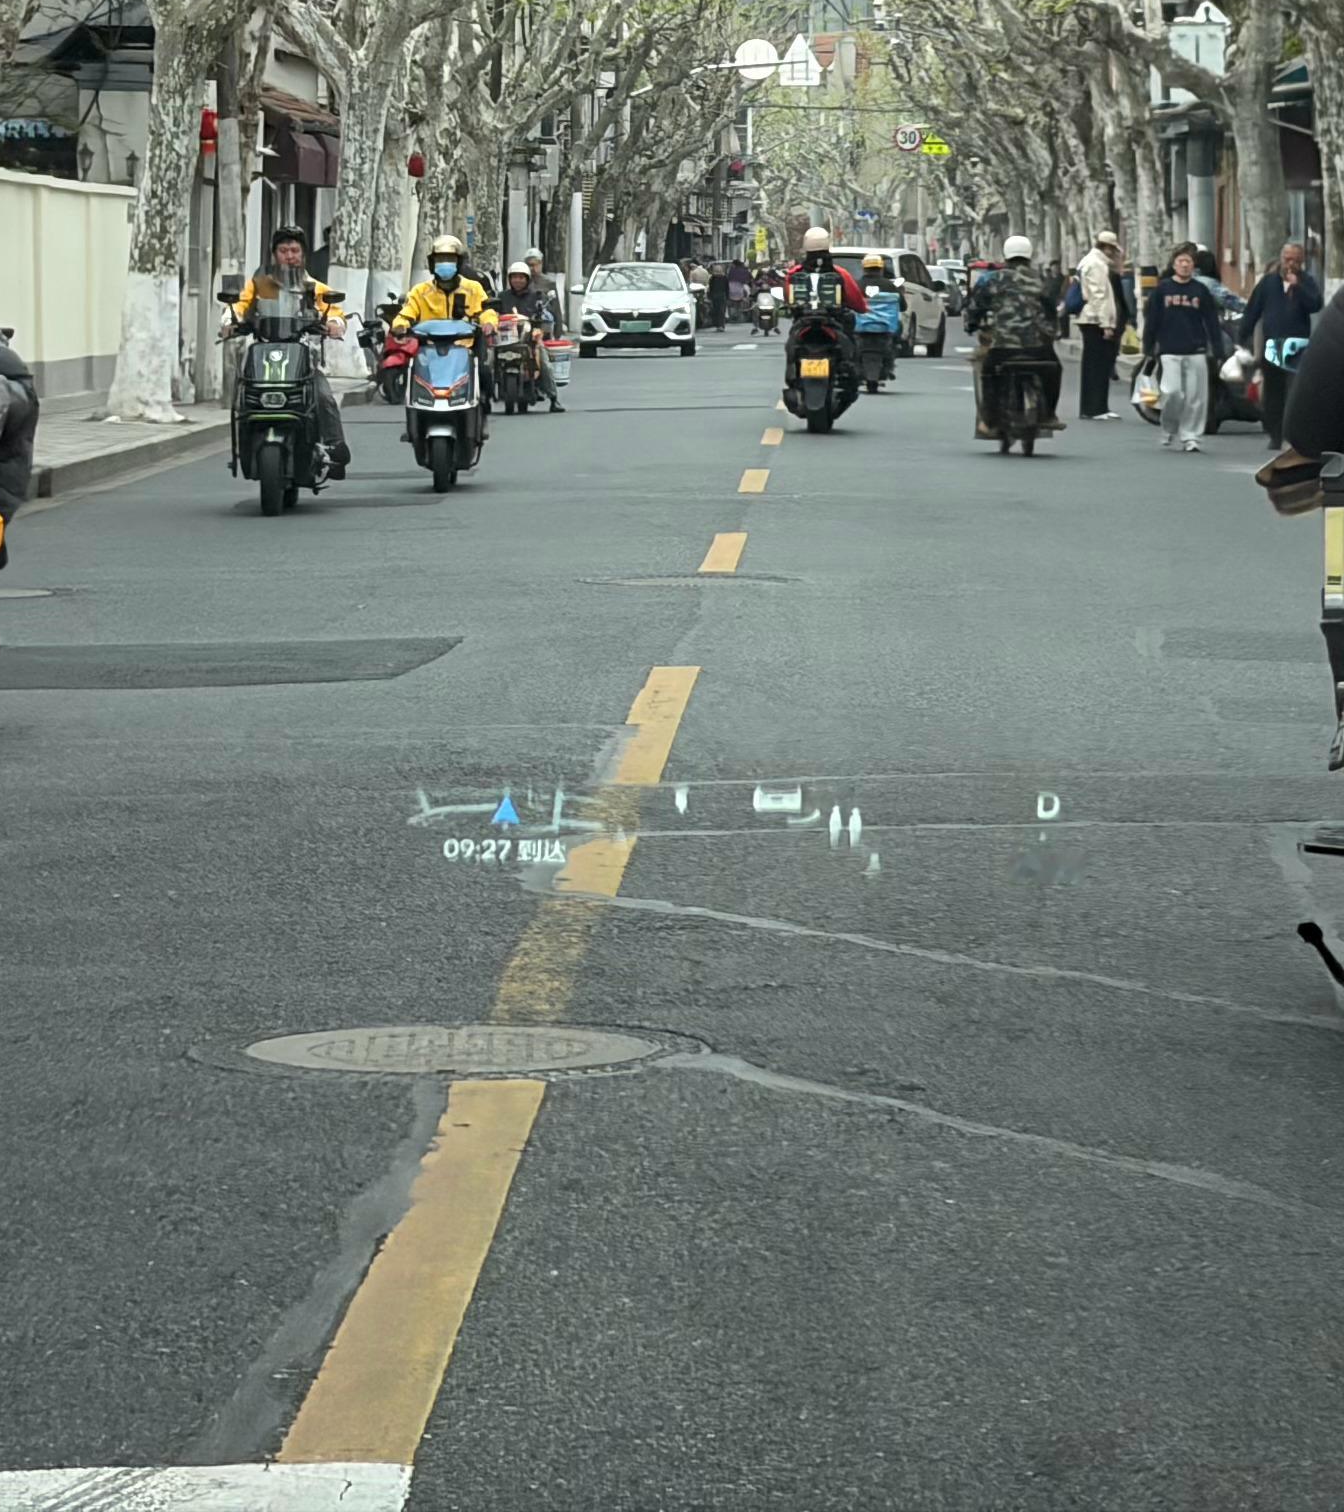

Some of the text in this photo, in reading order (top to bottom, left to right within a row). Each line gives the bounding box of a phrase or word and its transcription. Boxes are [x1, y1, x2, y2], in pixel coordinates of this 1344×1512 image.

[899, 130, 916, 145] 30
[1037, 791, 1060, 819] D
[443, 838, 566, 863] 09:27 到达
